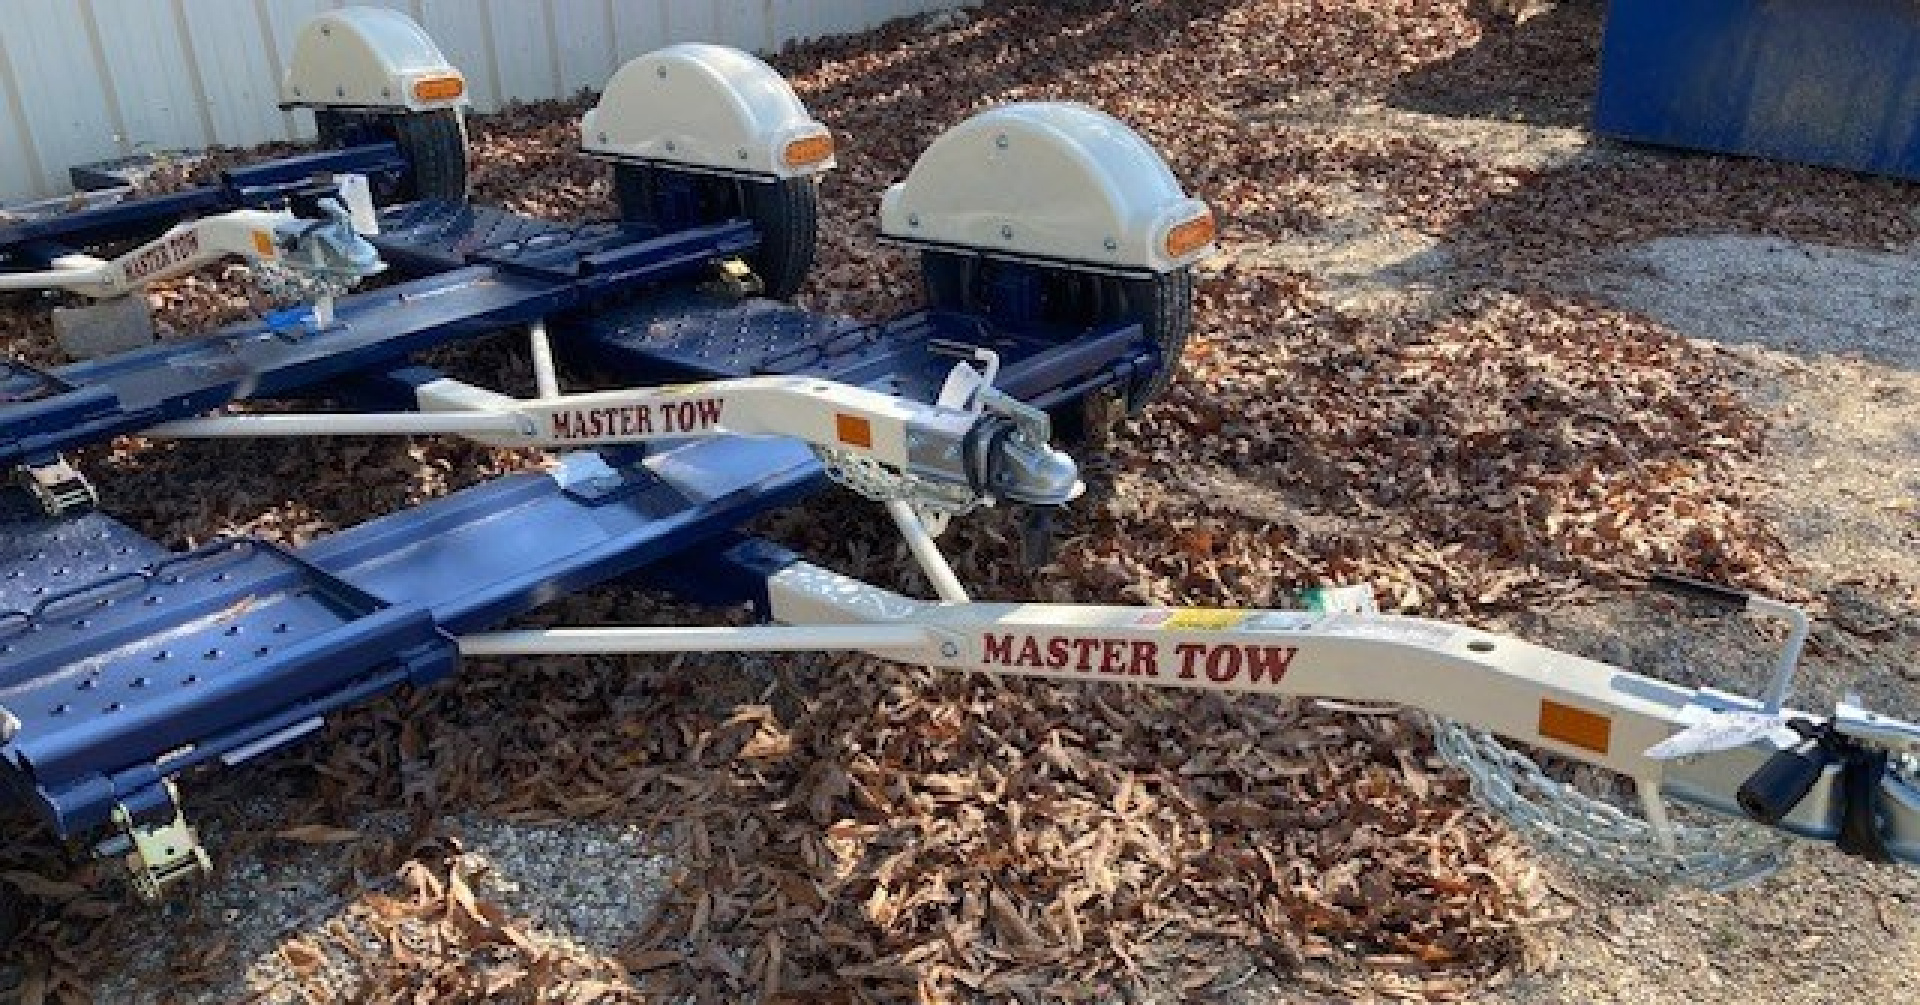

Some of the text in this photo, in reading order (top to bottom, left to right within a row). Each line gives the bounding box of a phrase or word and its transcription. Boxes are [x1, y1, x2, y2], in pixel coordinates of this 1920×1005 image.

[552, 399, 724, 439] MASTER TOW
[981, 632, 1297, 684] MASTER TOW
